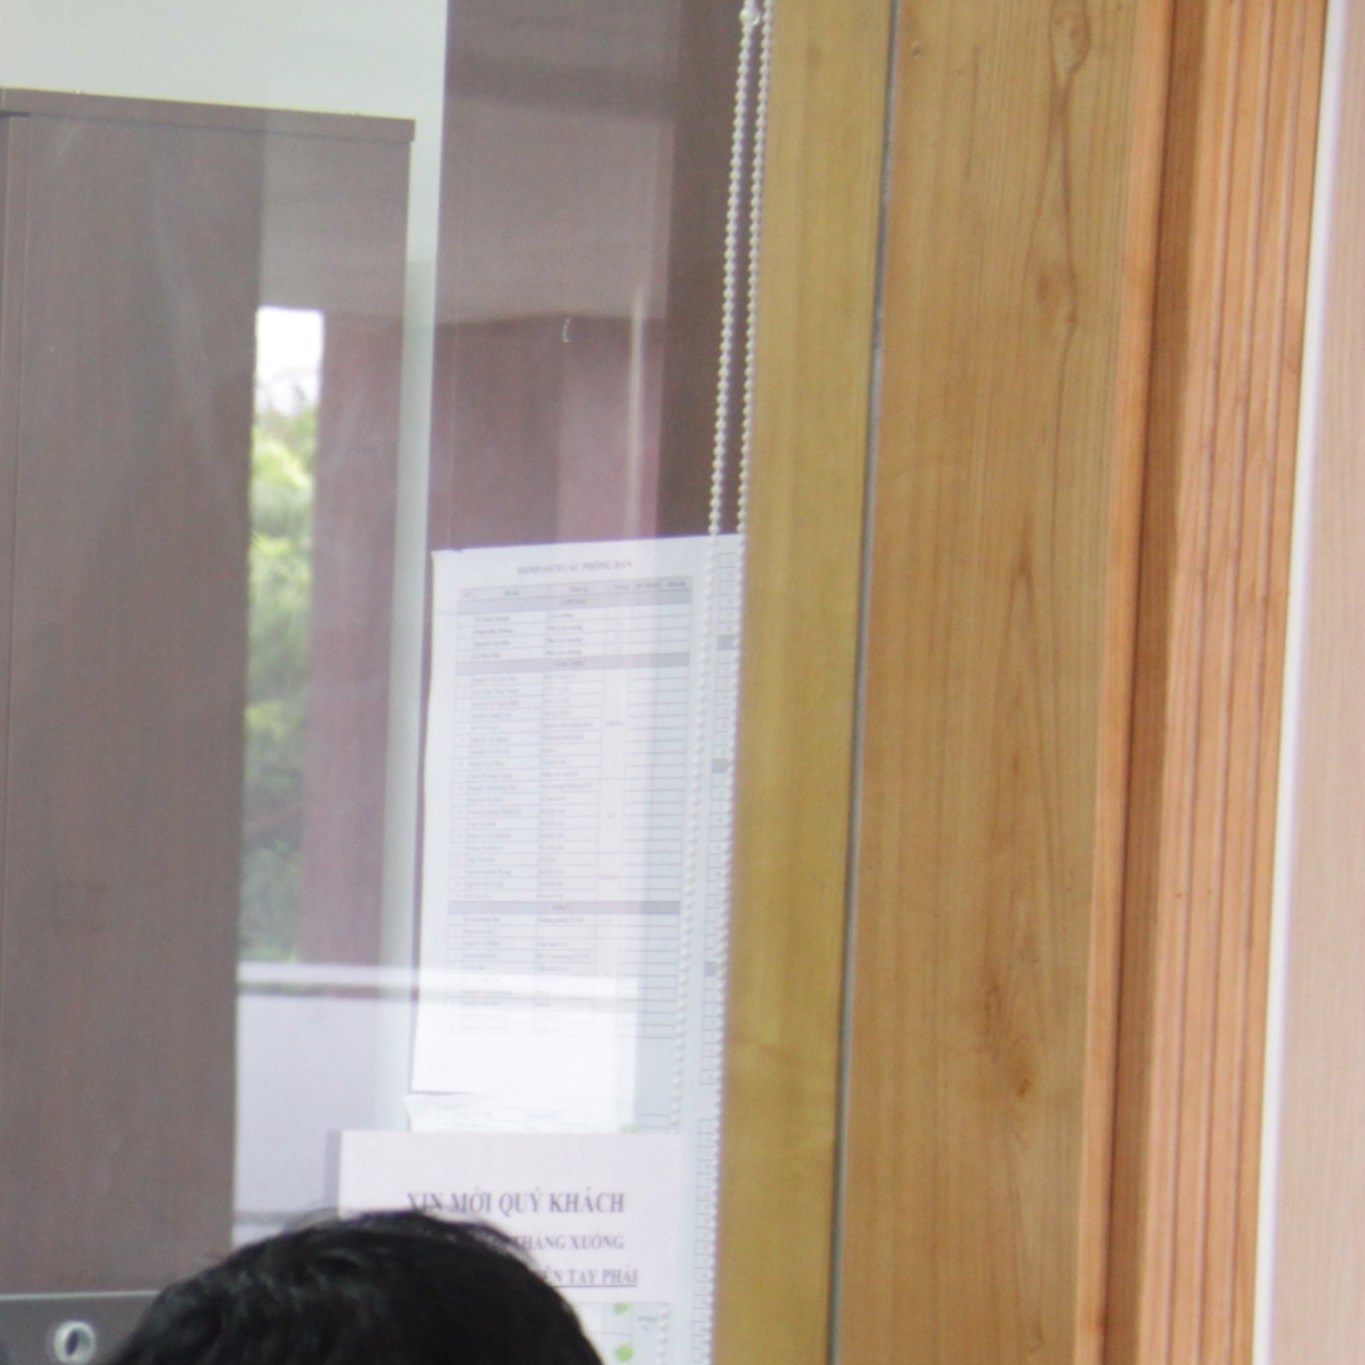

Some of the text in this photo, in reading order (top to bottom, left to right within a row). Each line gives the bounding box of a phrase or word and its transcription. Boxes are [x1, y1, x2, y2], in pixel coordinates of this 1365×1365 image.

[407, 1192, 447, 1212] XIN
[498, 1187, 544, 1216] QUÝ
[548, 1187, 626, 1213] KHÁCH
[566, 1268, 599, 1285] TAY
